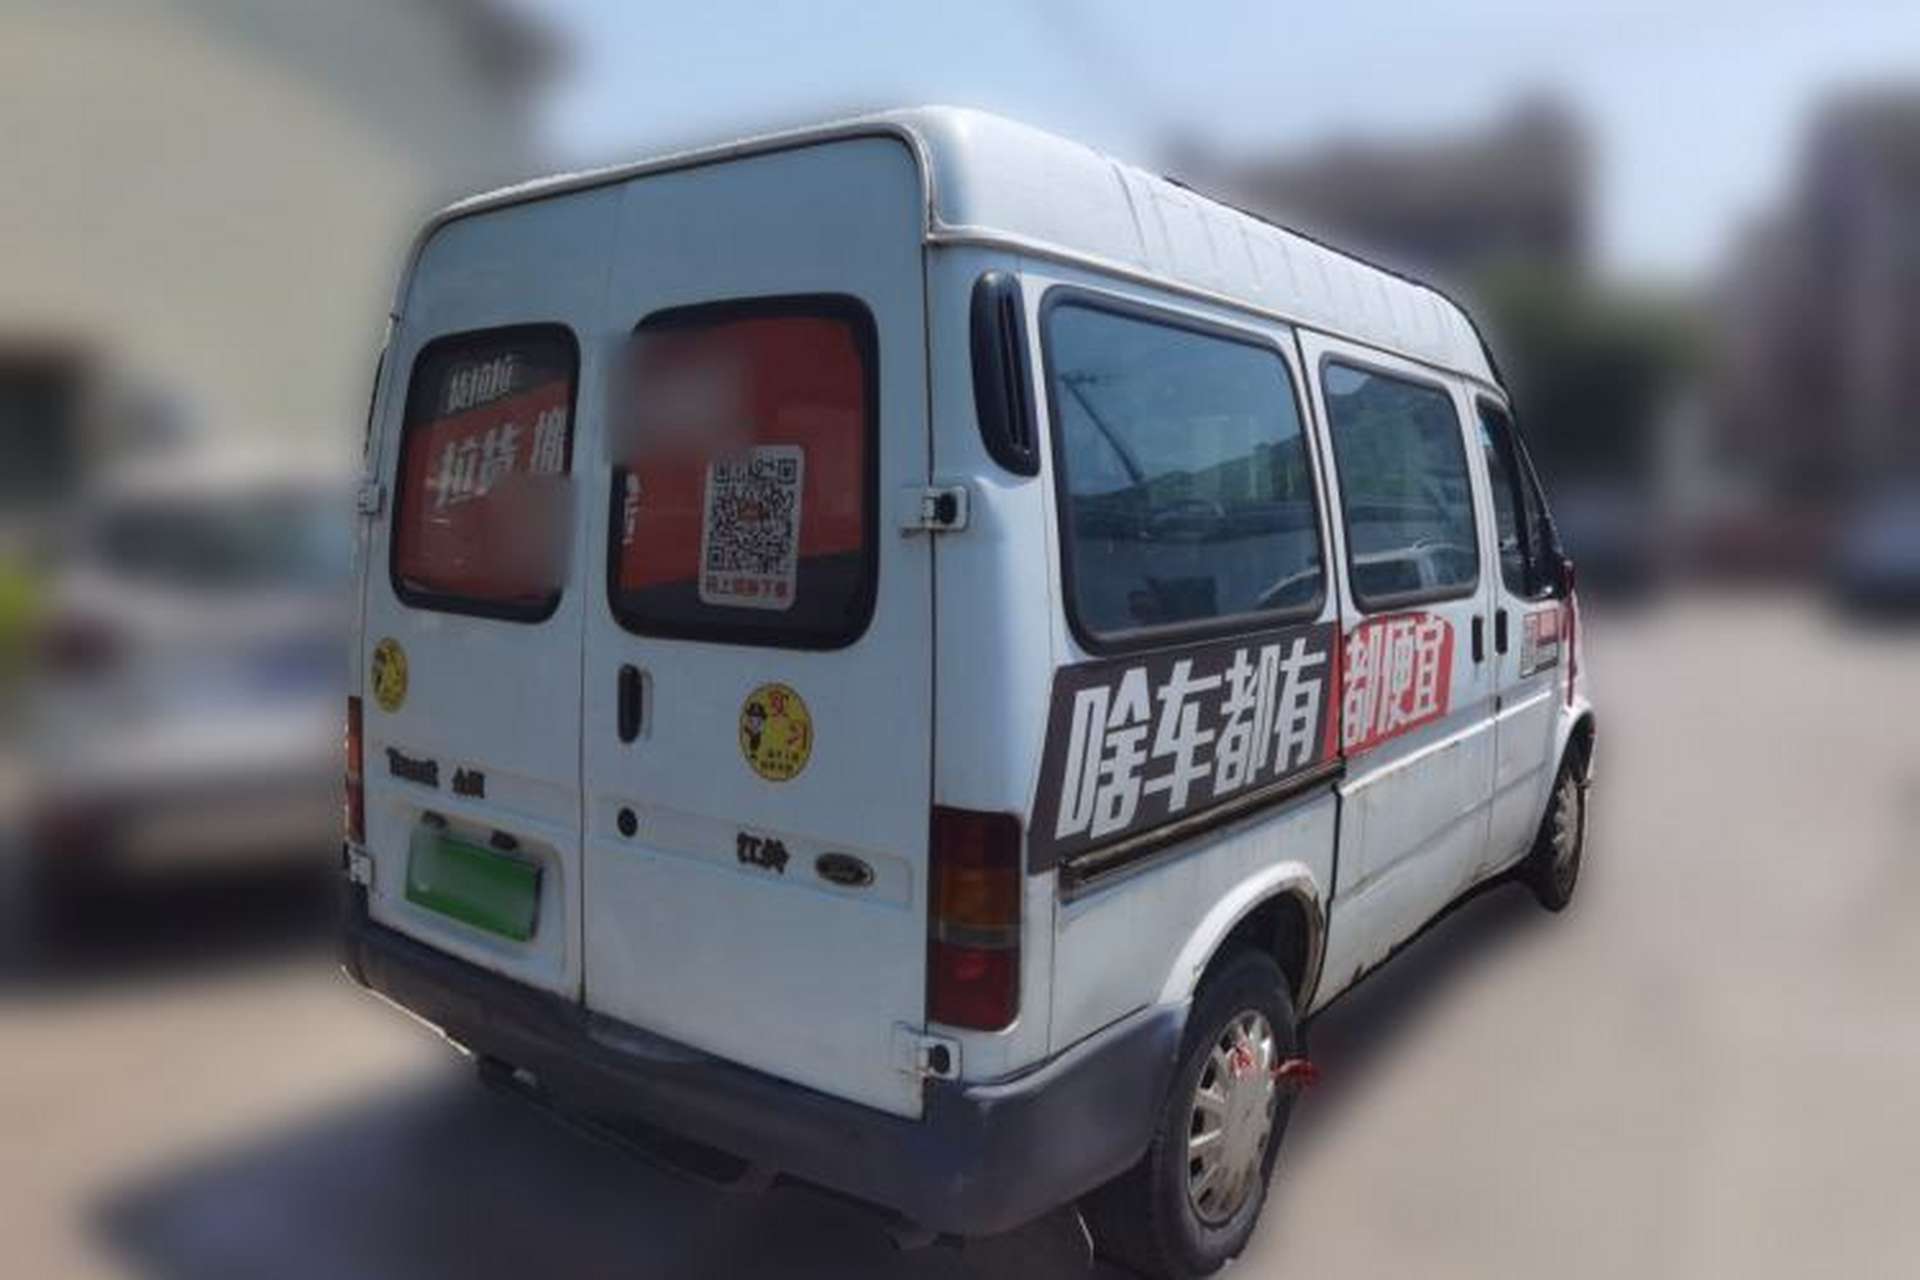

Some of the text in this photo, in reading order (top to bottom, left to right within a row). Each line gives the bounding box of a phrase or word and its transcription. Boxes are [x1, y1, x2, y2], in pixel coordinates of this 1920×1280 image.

[1055, 613, 1446, 841] 啥车都有 都便宜
